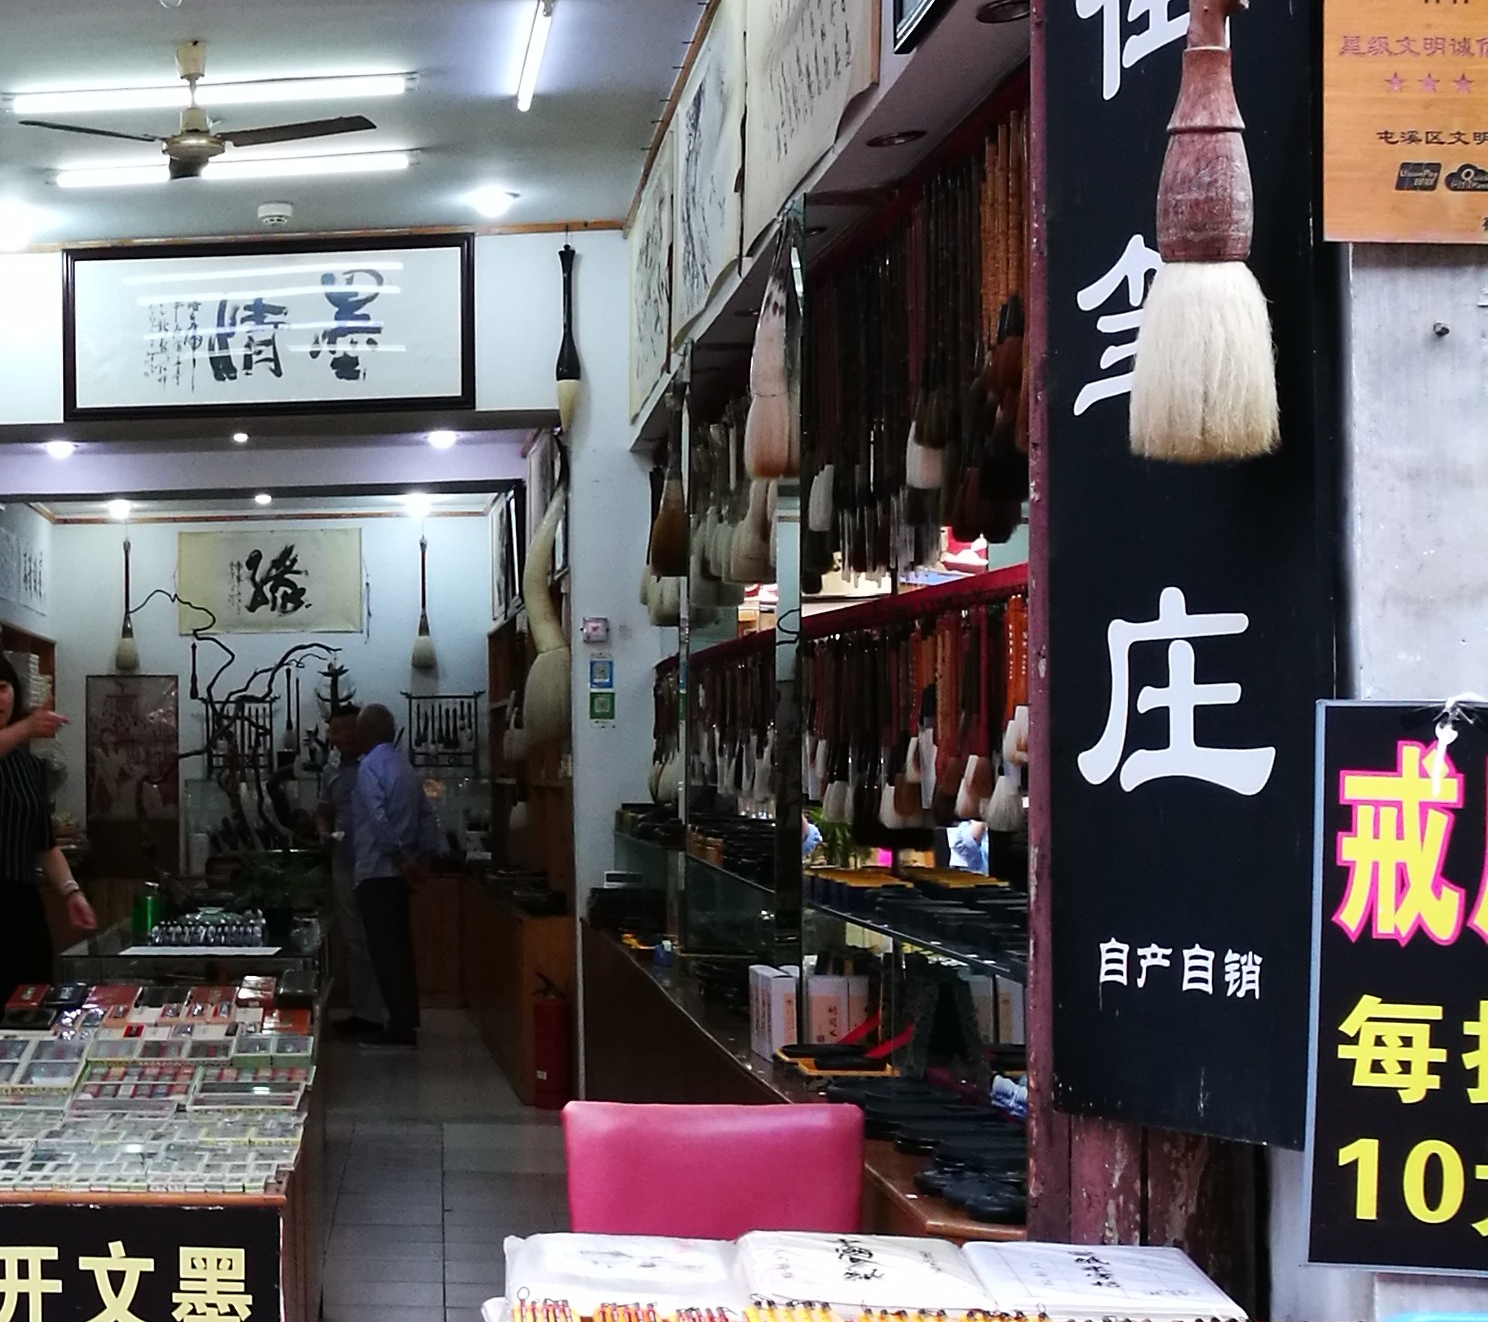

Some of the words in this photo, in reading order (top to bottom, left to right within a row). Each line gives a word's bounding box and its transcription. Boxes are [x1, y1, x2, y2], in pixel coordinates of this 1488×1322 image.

[1332, 740, 1488, 946] 戒
[1099, 937, 1262, 1000] 自产自销
[1337, 994, 1488, 1105] 每
[1338, 1138, 1488, 1237] 10
